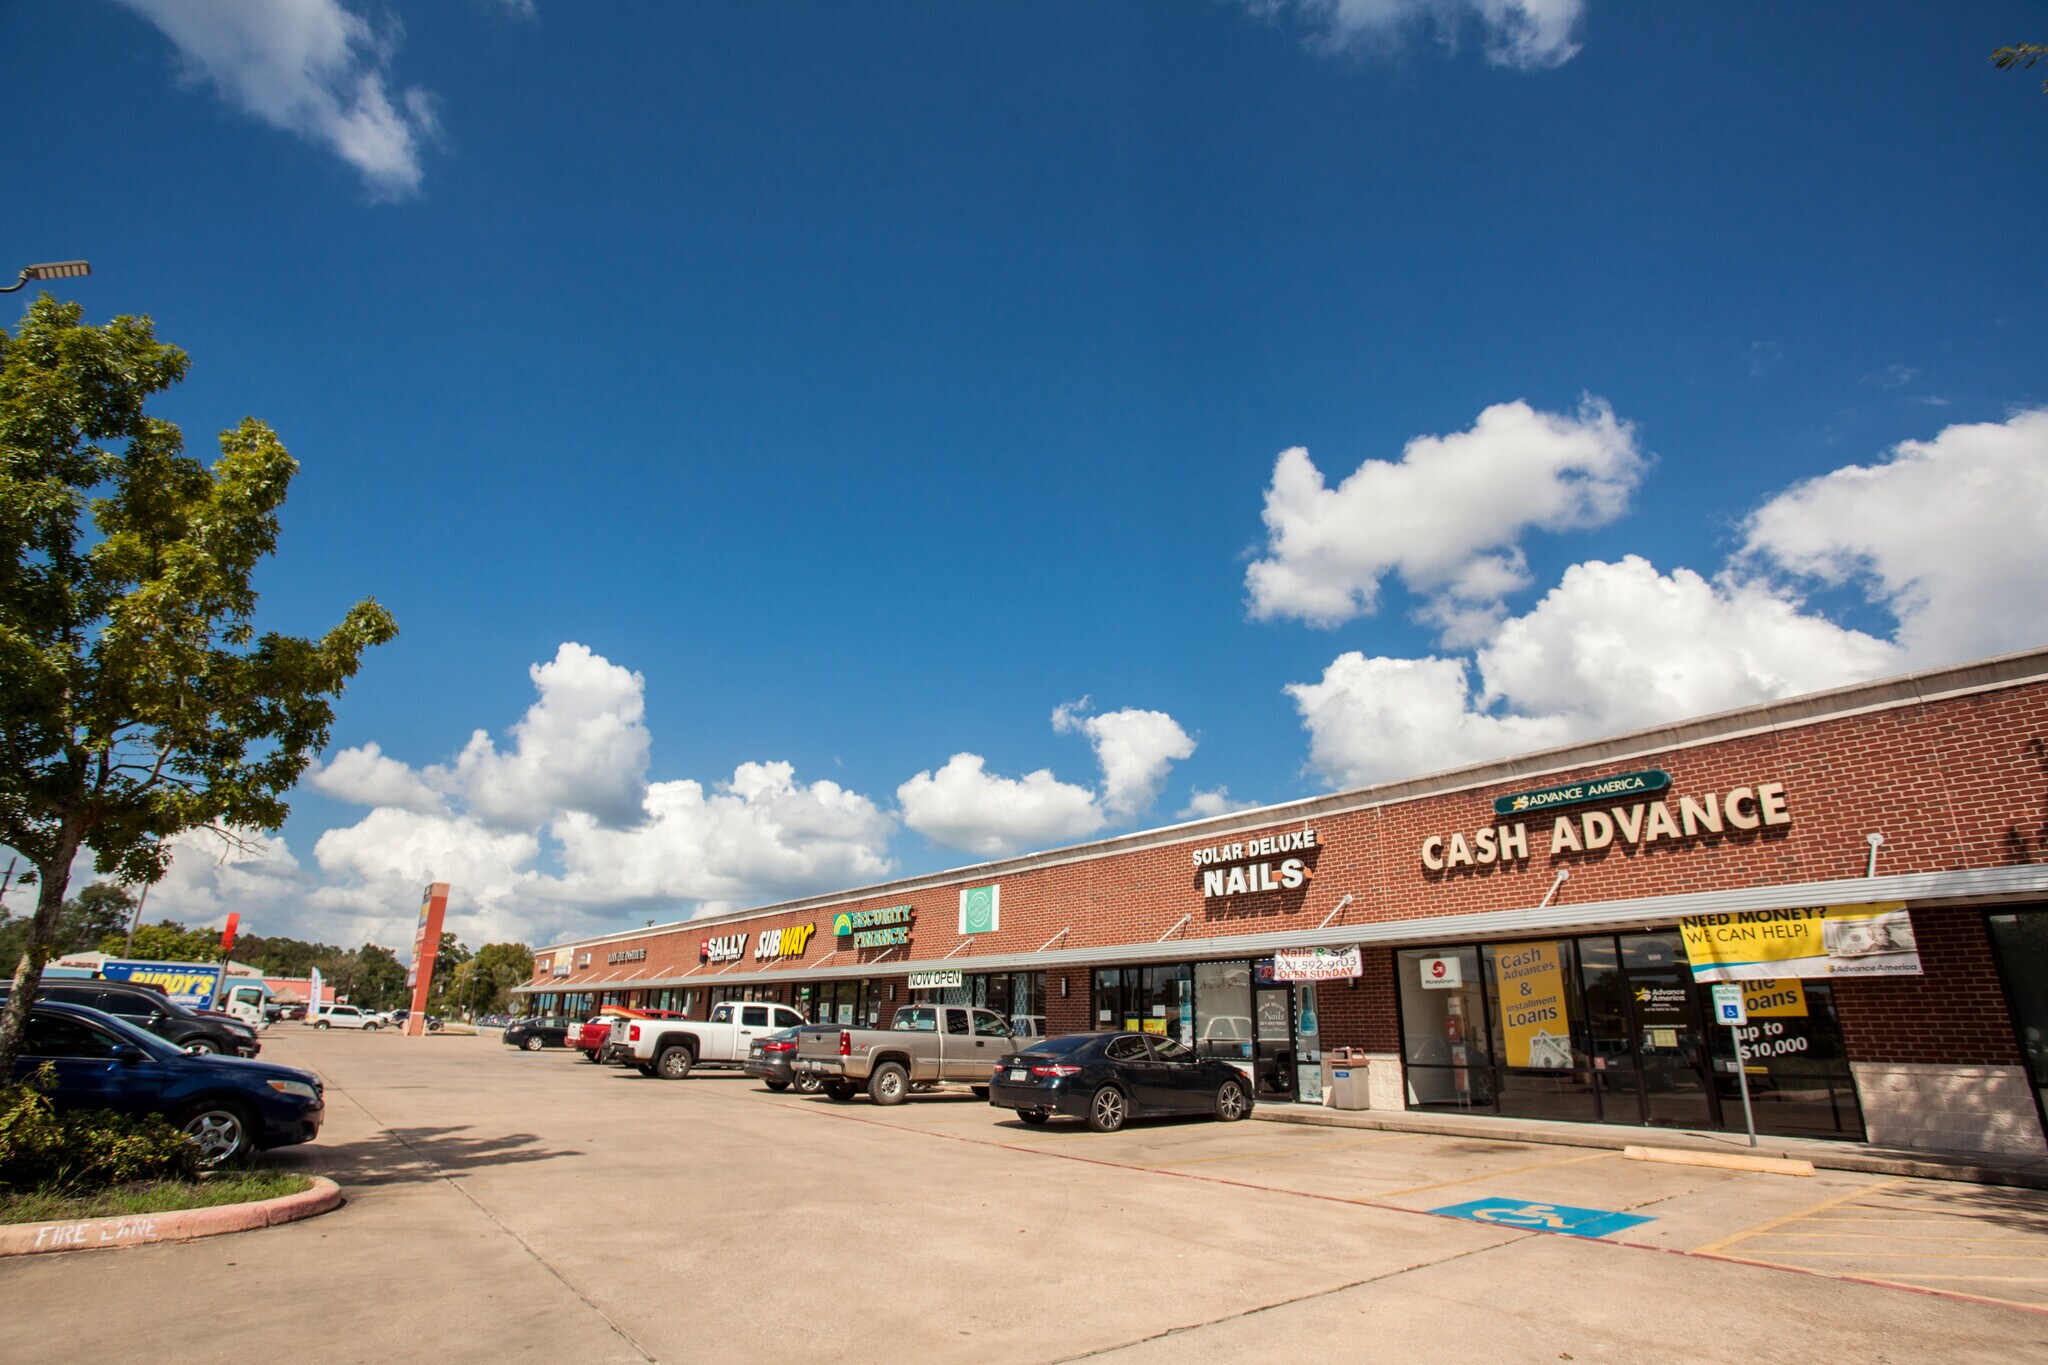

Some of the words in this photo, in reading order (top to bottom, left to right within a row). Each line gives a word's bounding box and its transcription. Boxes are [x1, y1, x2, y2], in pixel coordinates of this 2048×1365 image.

[1529, 787, 1583, 805] ADVANCE
[1588, 776, 1645, 796] AMERICA
[1421, 822, 1530, 871] CASH
[1550, 782, 1792, 854] ADVANCE
[1192, 843, 1244, 866] SOLAR
[1248, 830, 1315, 857] DELUXE
[1203, 858, 1304, 898] NAILS
[853, 905, 912, 928] SECURITY
[1682, 911, 1731, 929] NEED
[1737, 906, 1828, 924] MONEY?
[754, 922, 815, 958] SUBWAY
[853, 927, 908, 948] FINANCE
[1686, 928, 1712, 944] WE
[1716, 926, 1756, 942] CAN
[1762, 923, 1809, 939] HELP!
[707, 933, 748, 958] SALLY
[1280, 947, 1313, 958] Nails
[1315, 947, 1326, 957] &
[1501, 947, 1542, 970] Cash
[1837, 964, 1876, 972] Advance
[1877, 963, 1917, 971] America
[909, 972, 933, 986] NOW
[934, 970, 960, 985] OPEN
[1279, 970, 1307, 979] OPEN
[1310, 967, 1354, 979] SUNDAY
[1425, 978, 1456, 986] MoneyGram
[1503, 962, 1555, 981] Advances
[1519, 981, 1533, 996] &
[1651, 988, 1686, 996] Advance
[1506, 995, 1557, 1013] Installment
[1745, 989, 1798, 1012] oans
[1264, 1011, 1285, 1020] Nails
[1508, 1006, 1557, 1028] Loans
[1739, 1026, 1760, 1042] up
[1763, 1022, 1784, 1036] to
[1740, 1036, 1808, 1060] $10,000
[35, 1222, 93, 1248] FIRE
[100, 1218, 158, 1242] LANE
